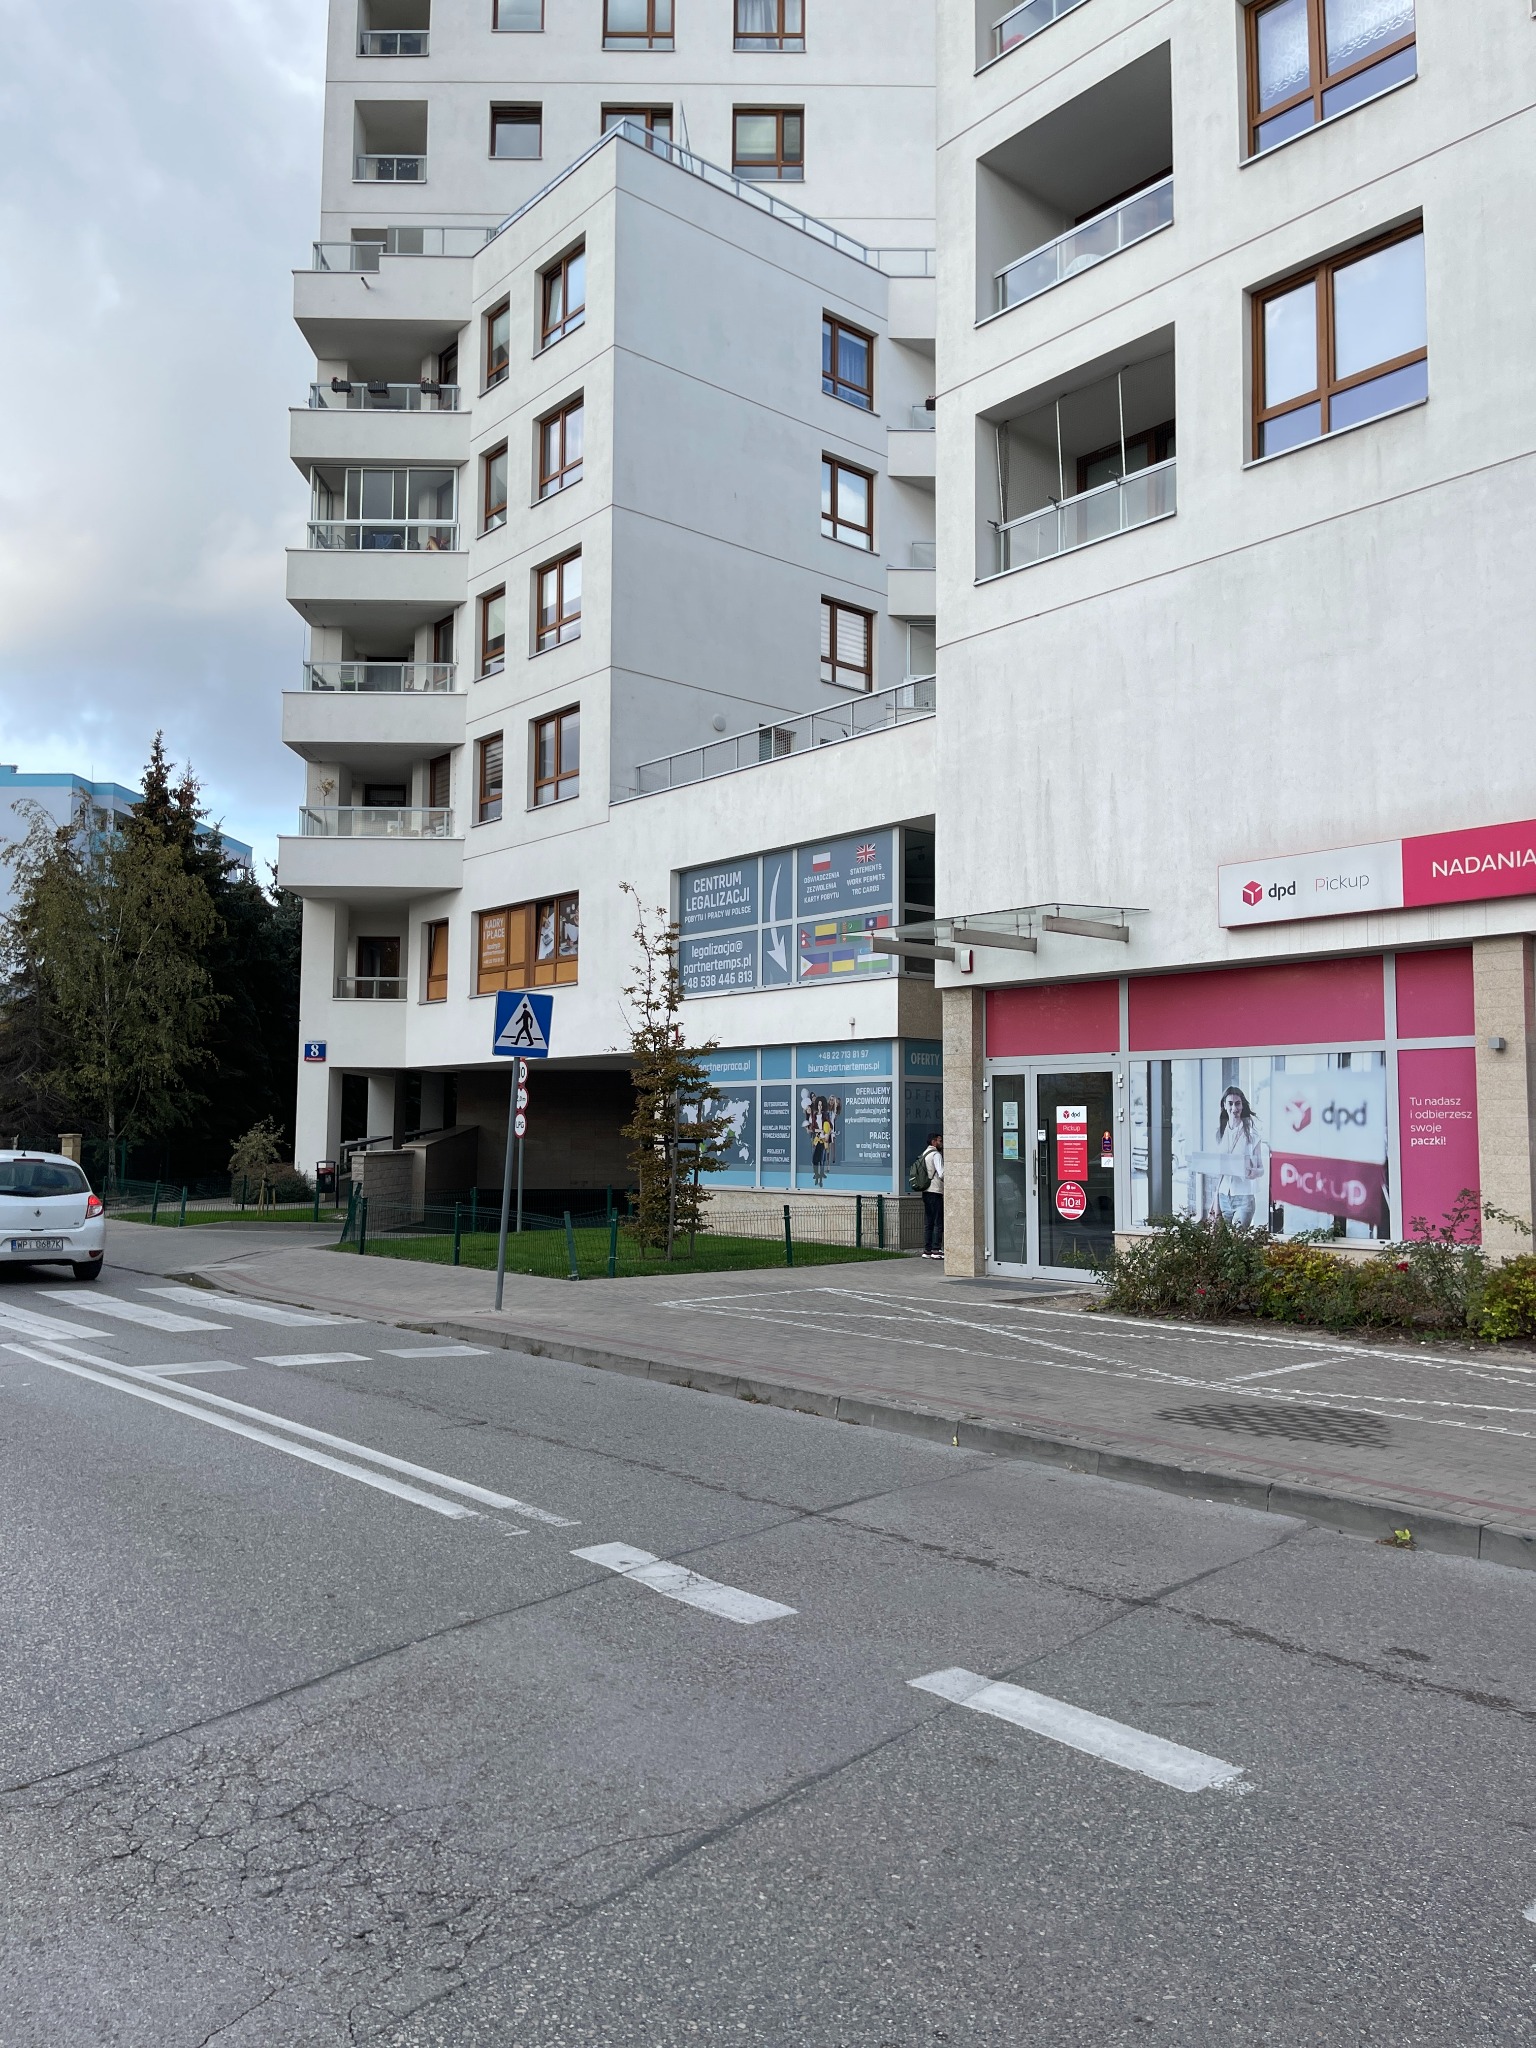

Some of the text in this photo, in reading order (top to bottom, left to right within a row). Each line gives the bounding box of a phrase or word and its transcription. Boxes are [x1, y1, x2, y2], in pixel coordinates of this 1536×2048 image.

[1432, 848, 1536, 878] NADANIA
[850, 864, 882, 876] STATEMENTS
[694, 870, 742, 894] CENTRUM
[804, 871, 840, 884] OŚWIADCZENIA
[846, 873, 886, 886] WORK PERMITS
[806, 882, 837, 894] ZEZWOLENIA
[852, 884, 880, 896] TRC CARDS
[1268, 874, 1370, 900] dpd Pickup
[686, 886, 750, 912] LEGALIZACJI
[804, 892, 840, 904] KARTY POBYTU
[684, 912, 704, 923] POBYTU
[708, 910, 724, 919] PRACY
[724, 908, 731, 916] W
[732, 906, 752, 916] POLSCE
[484, 918, 504, 929] KADRY
[487, 928, 505, 939] PŁACE
[692, 940, 743, 959] legalizacja@
[684, 954, 752, 976] partnertemps.pl
[683, 970, 752, 988] +48 538 446 813
[310, 1044, 319, 1057] 8
[841, 1051, 851, 1059] 713
[911, 1052, 940, 1065] OFERTY
[808, 1061, 880, 1073] biuro@partnertemps.pl
[856, 1087, 890, 1095] OFERUJEMY
[846, 1095, 890, 1105] PRACOWNIKÓW
[1410, 1097, 1461, 1106] Tu nadasz
[1322, 1101, 1367, 1130] dpd
[1415, 1110, 1472, 1119] odbierzesz
[1410, 1124, 1442, 1133] swoje
[870, 1132, 890, 1140] PRACĘ:
[1411, 1136, 1446, 1147] paczki!
[1063, 1197, 1074, 1207] 10
